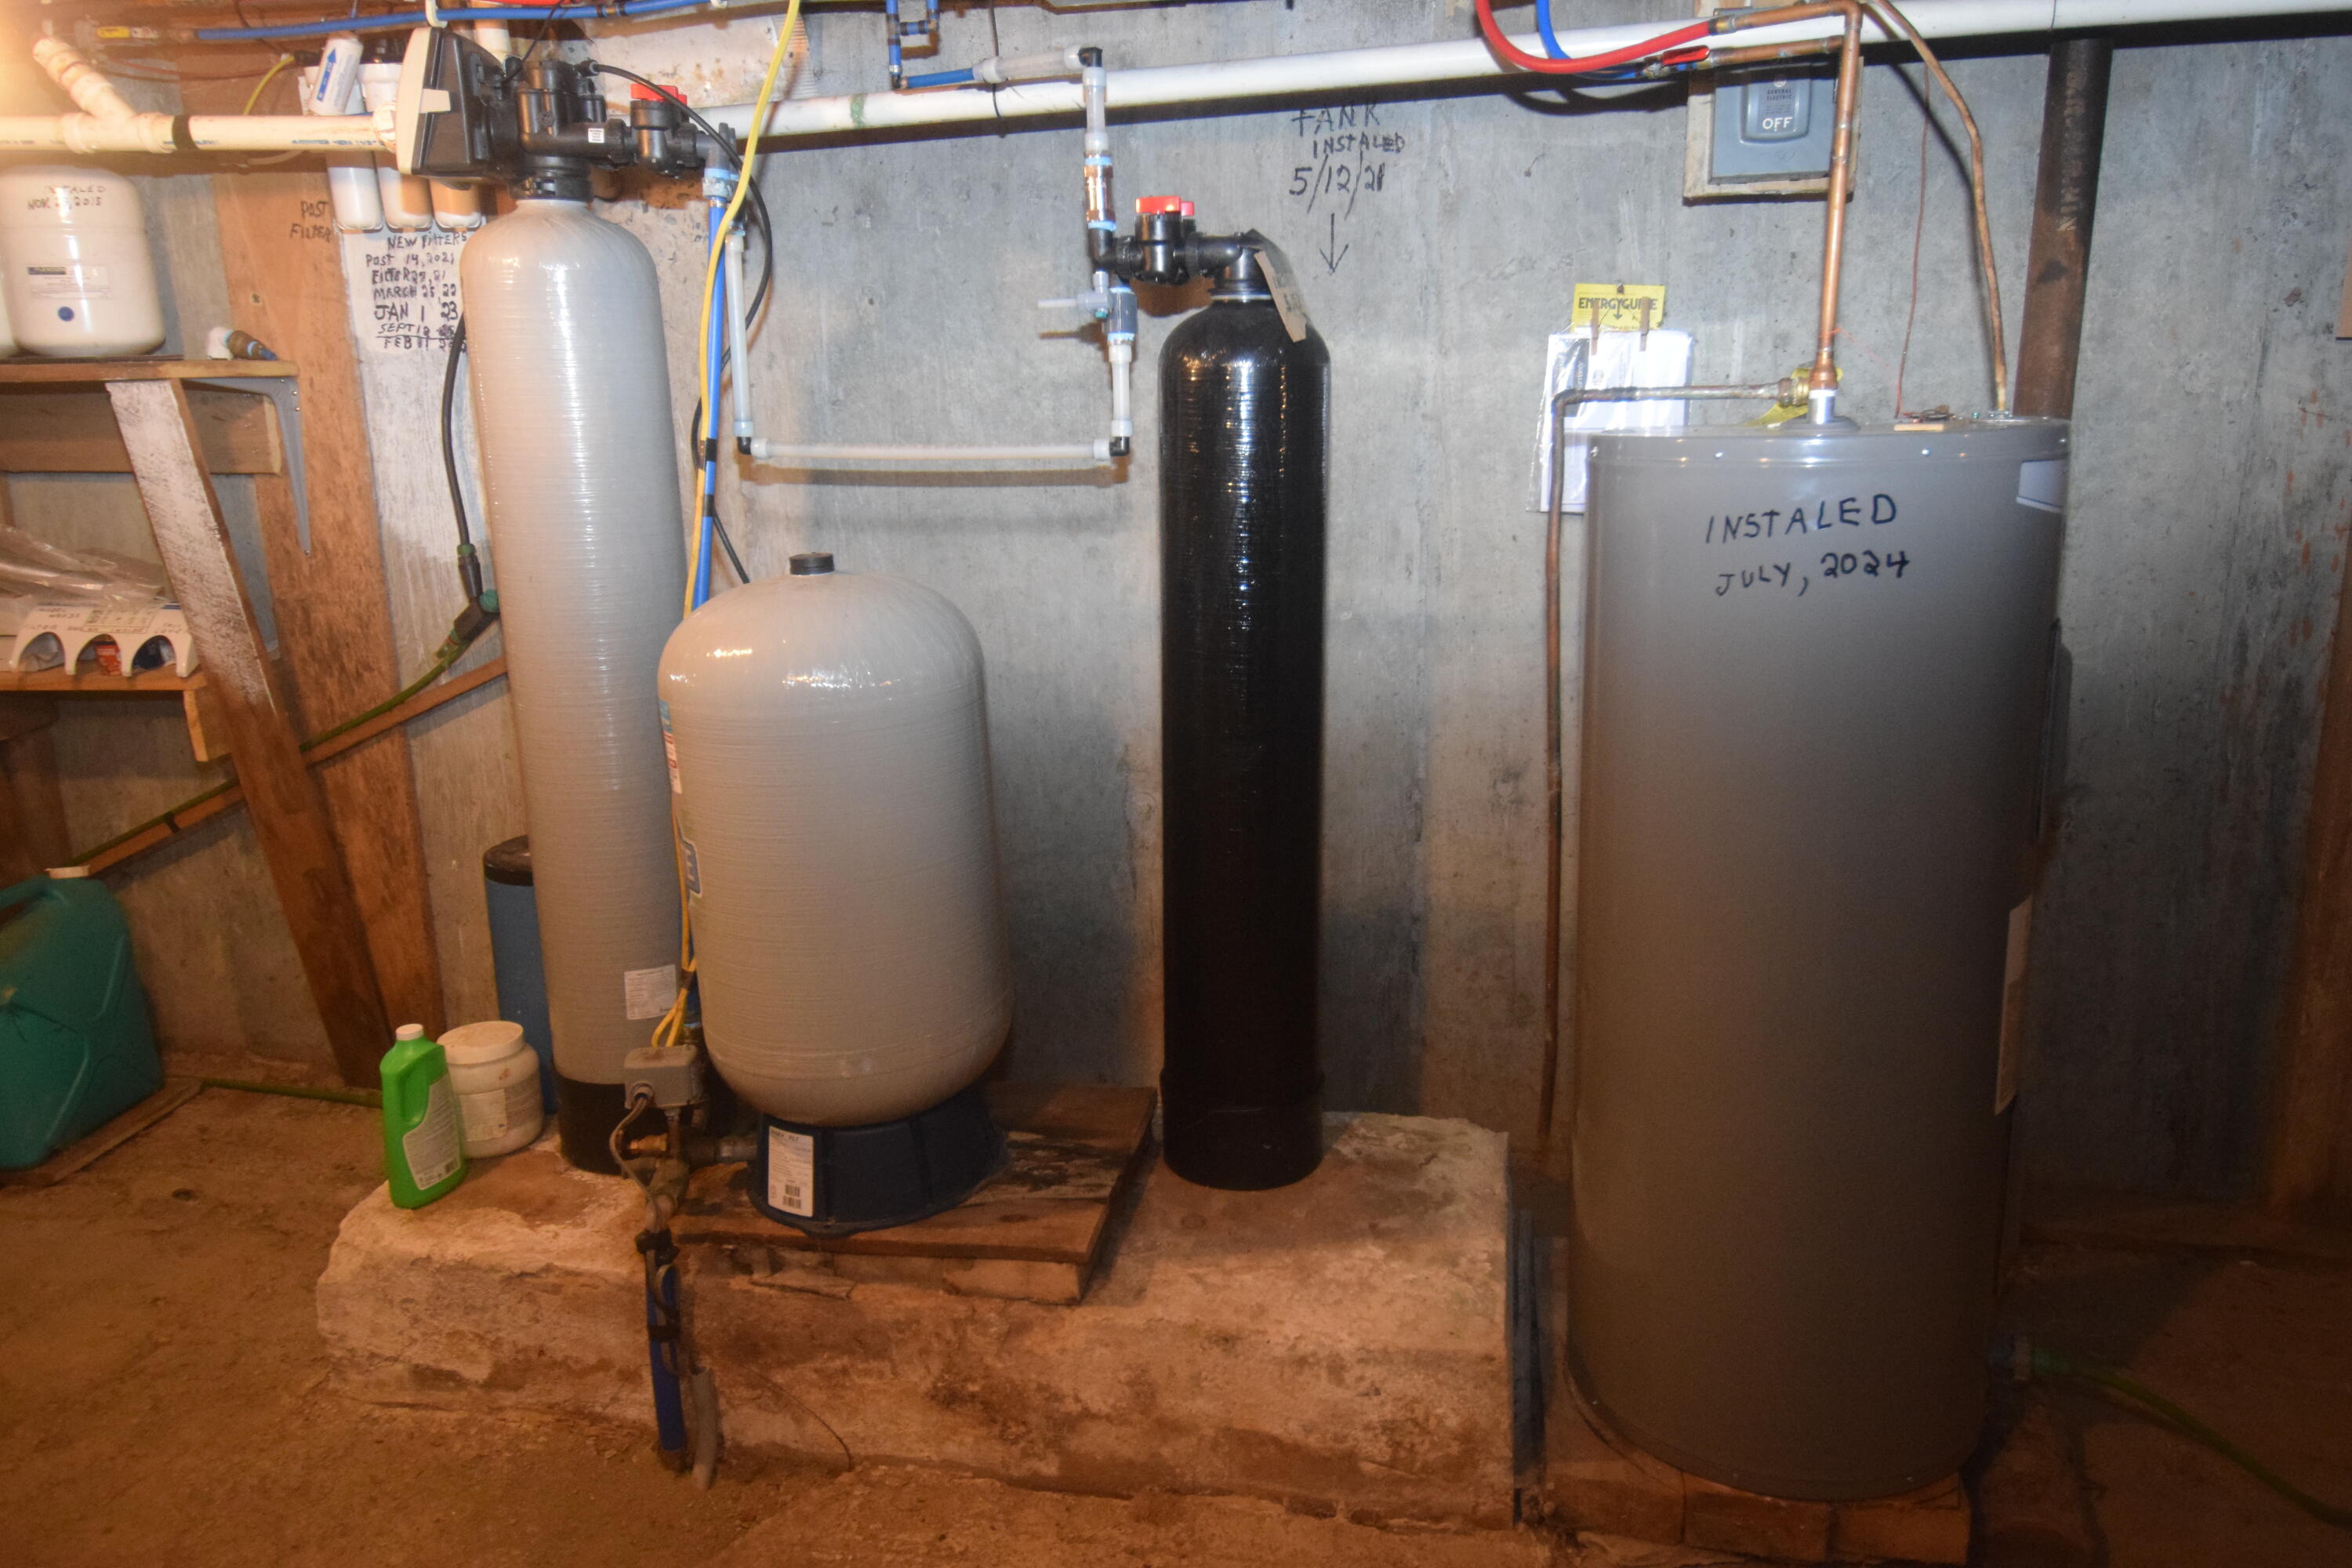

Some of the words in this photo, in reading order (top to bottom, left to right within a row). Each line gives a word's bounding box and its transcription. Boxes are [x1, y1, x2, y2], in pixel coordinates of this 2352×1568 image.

[1290, 104, 1381, 137] TANK
[1762, 116, 1793, 131] OFF
[387, 234, 417, 250] NEW
[373, 283, 417, 300] MARCH
[374, 301, 408, 322] JAN
[378, 322, 416, 334] SEPT
[384, 335, 412, 350] FEB
[1705, 494, 1896, 543] INSTALED
[1715, 562, 1809, 597] JULY,
[1820, 550, 1910, 579] 2024
